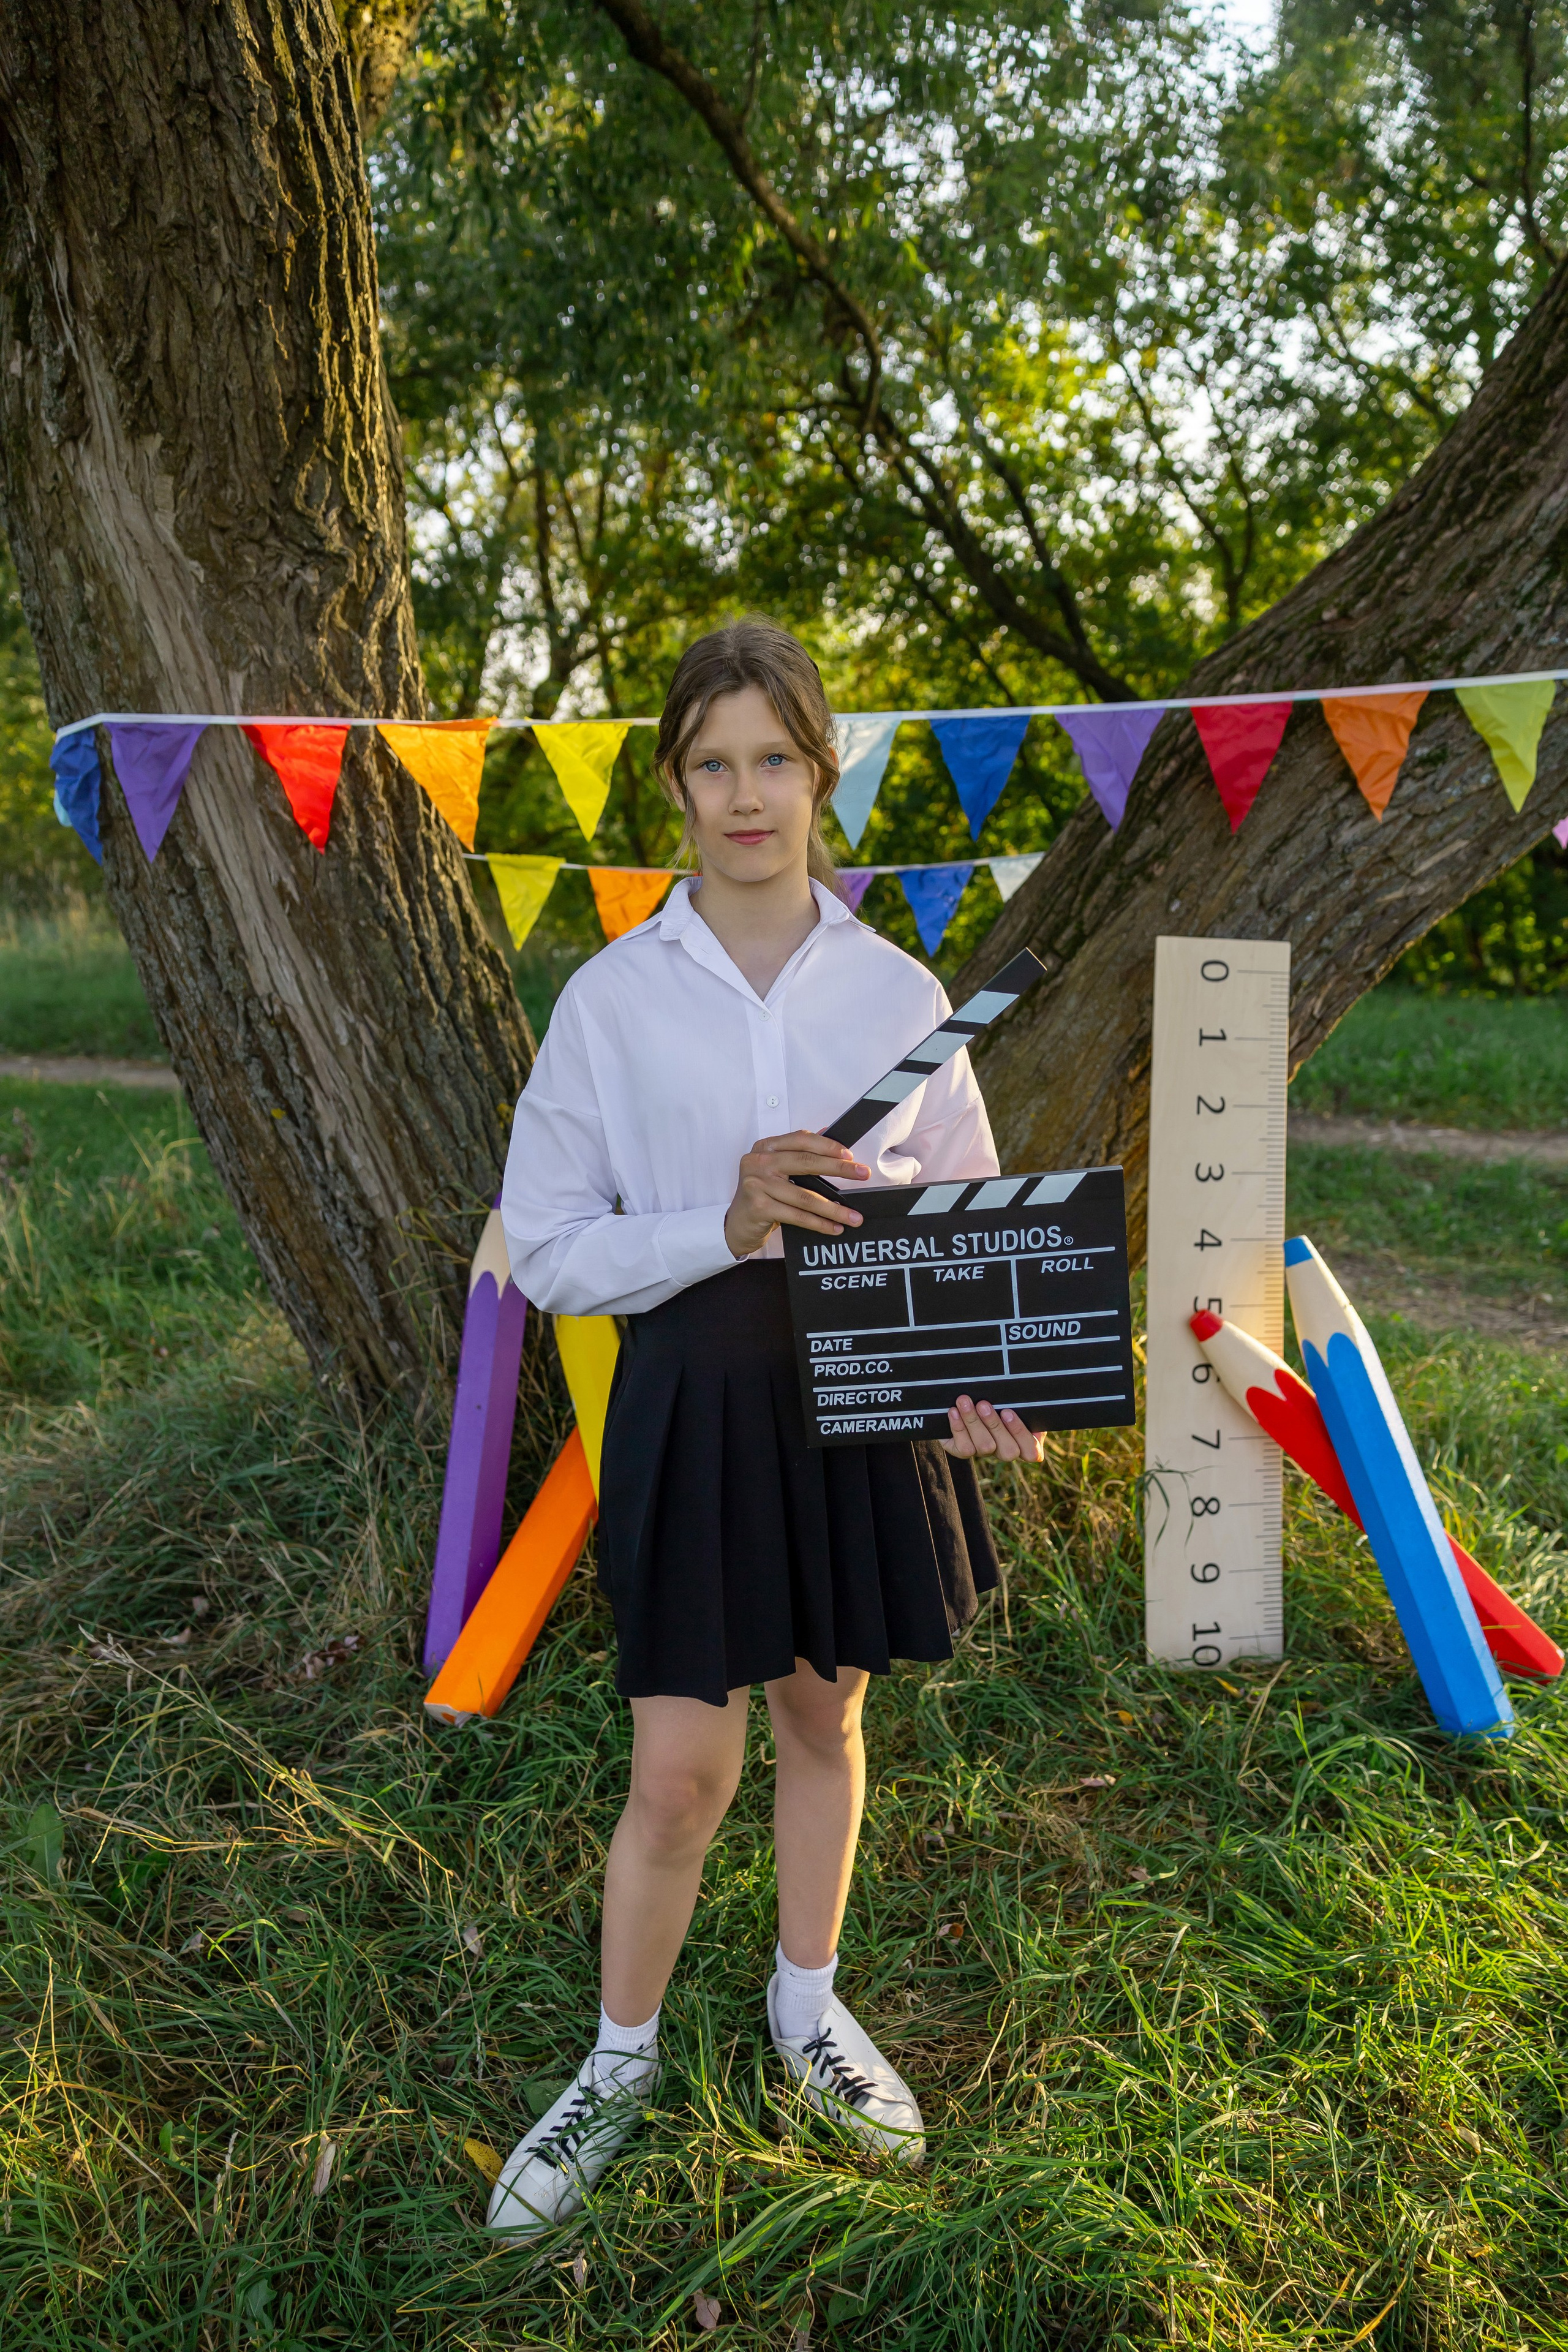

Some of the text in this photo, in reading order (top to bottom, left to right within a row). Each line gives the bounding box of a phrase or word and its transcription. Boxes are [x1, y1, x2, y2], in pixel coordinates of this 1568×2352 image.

[1199, 1028, 1227, 1046] 1
[1196, 1095, 1226, 1115] 2
[1195, 1163, 1224, 1183] 3
[1194, 1229, 1223, 1251] 4
[803, 1236, 944, 1267] UNIVERSAL
[933, 1265, 985, 1283] TAKE
[1041, 1257, 1094, 1273] ROLL
[821, 1273, 888, 1291] SCENE
[1008, 1321, 1081, 1341] SOUND
[810, 1338, 853, 1353] DATE
[814, 1360, 894, 1377] PROD.CO.
[817, 1389, 902, 1406] DIRECTOR
[820, 1416, 924, 1434] CAMERAMAN
[1191, 1430, 1221, 1450] 7
[1190, 1496, 1221, 1518] 8
[1190, 1562, 1221, 1584] 9
[1192, 1621, 1221, 1667] 10
